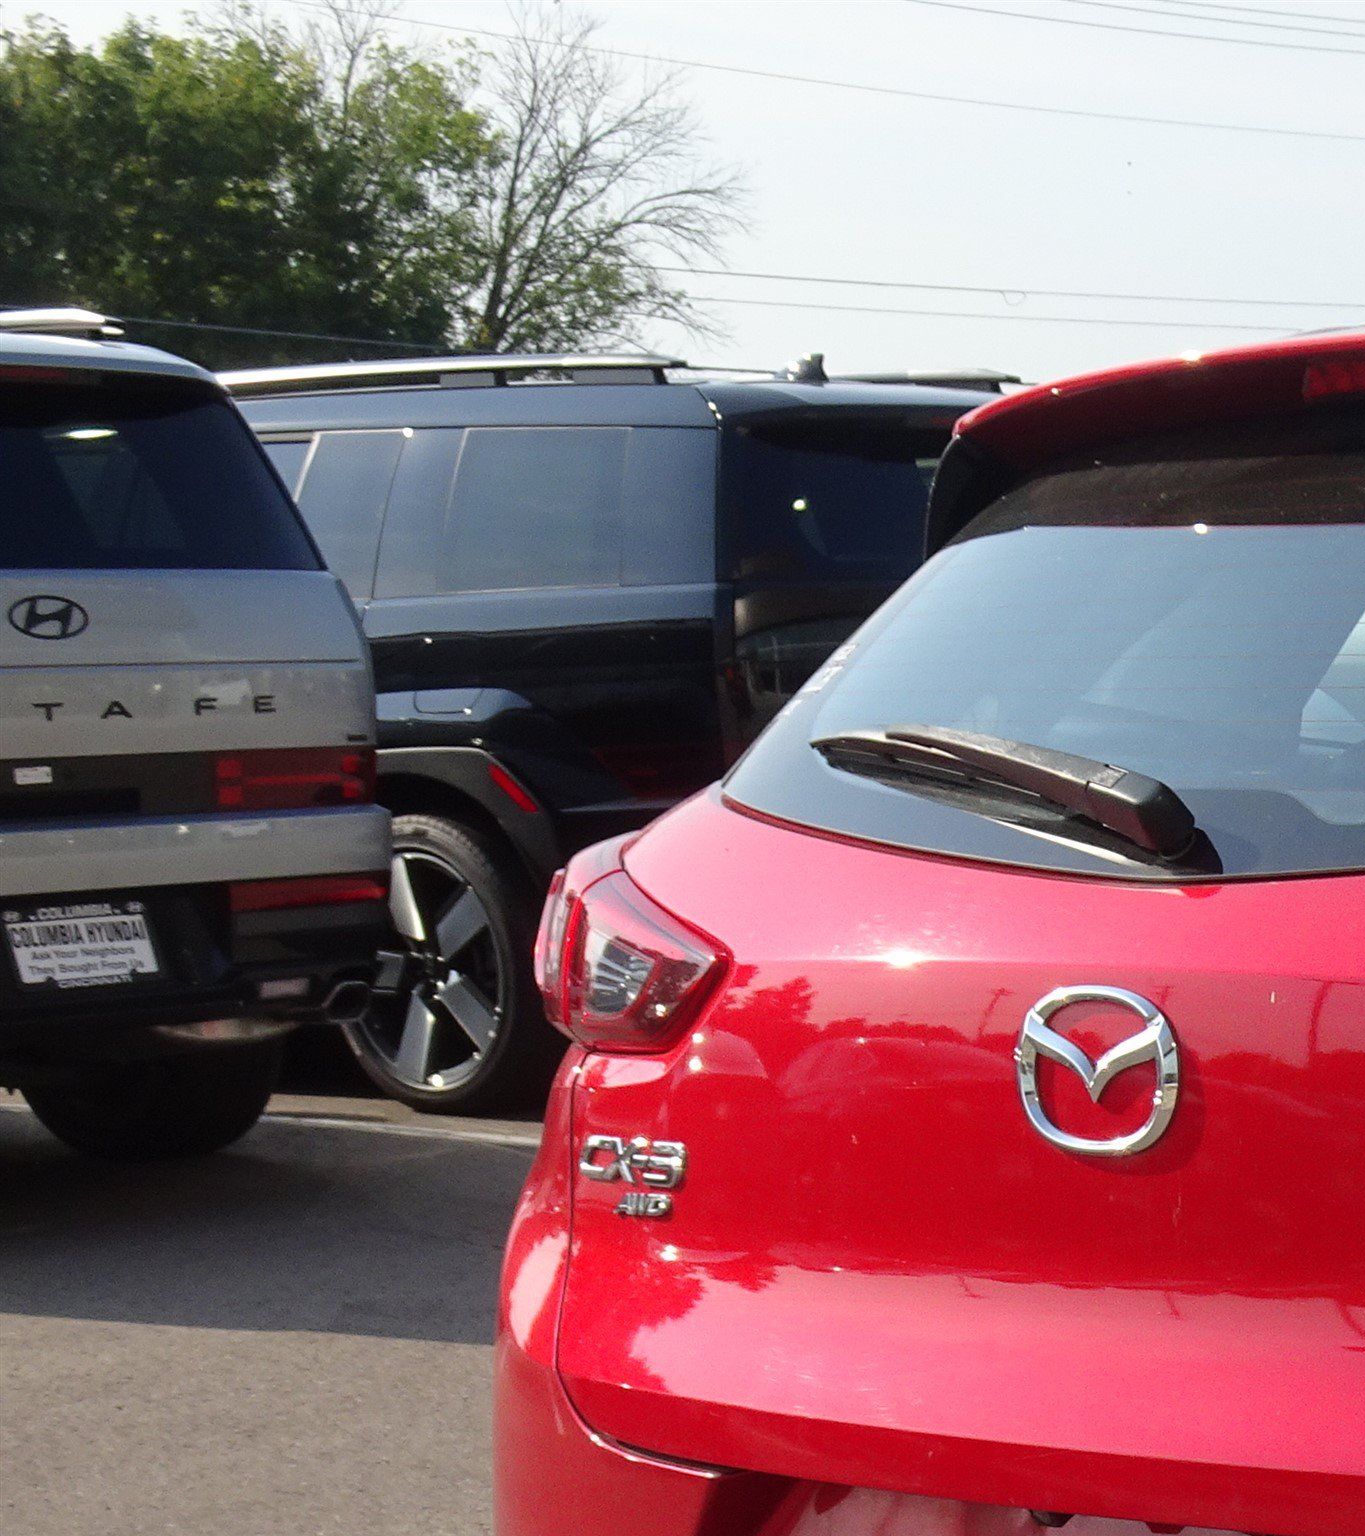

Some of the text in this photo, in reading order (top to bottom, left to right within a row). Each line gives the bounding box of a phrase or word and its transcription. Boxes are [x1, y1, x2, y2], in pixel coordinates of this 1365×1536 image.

[11, 919, 148, 948] COLUMBIA HYUNDAI
[579, 1135, 687, 1189] CX-3
